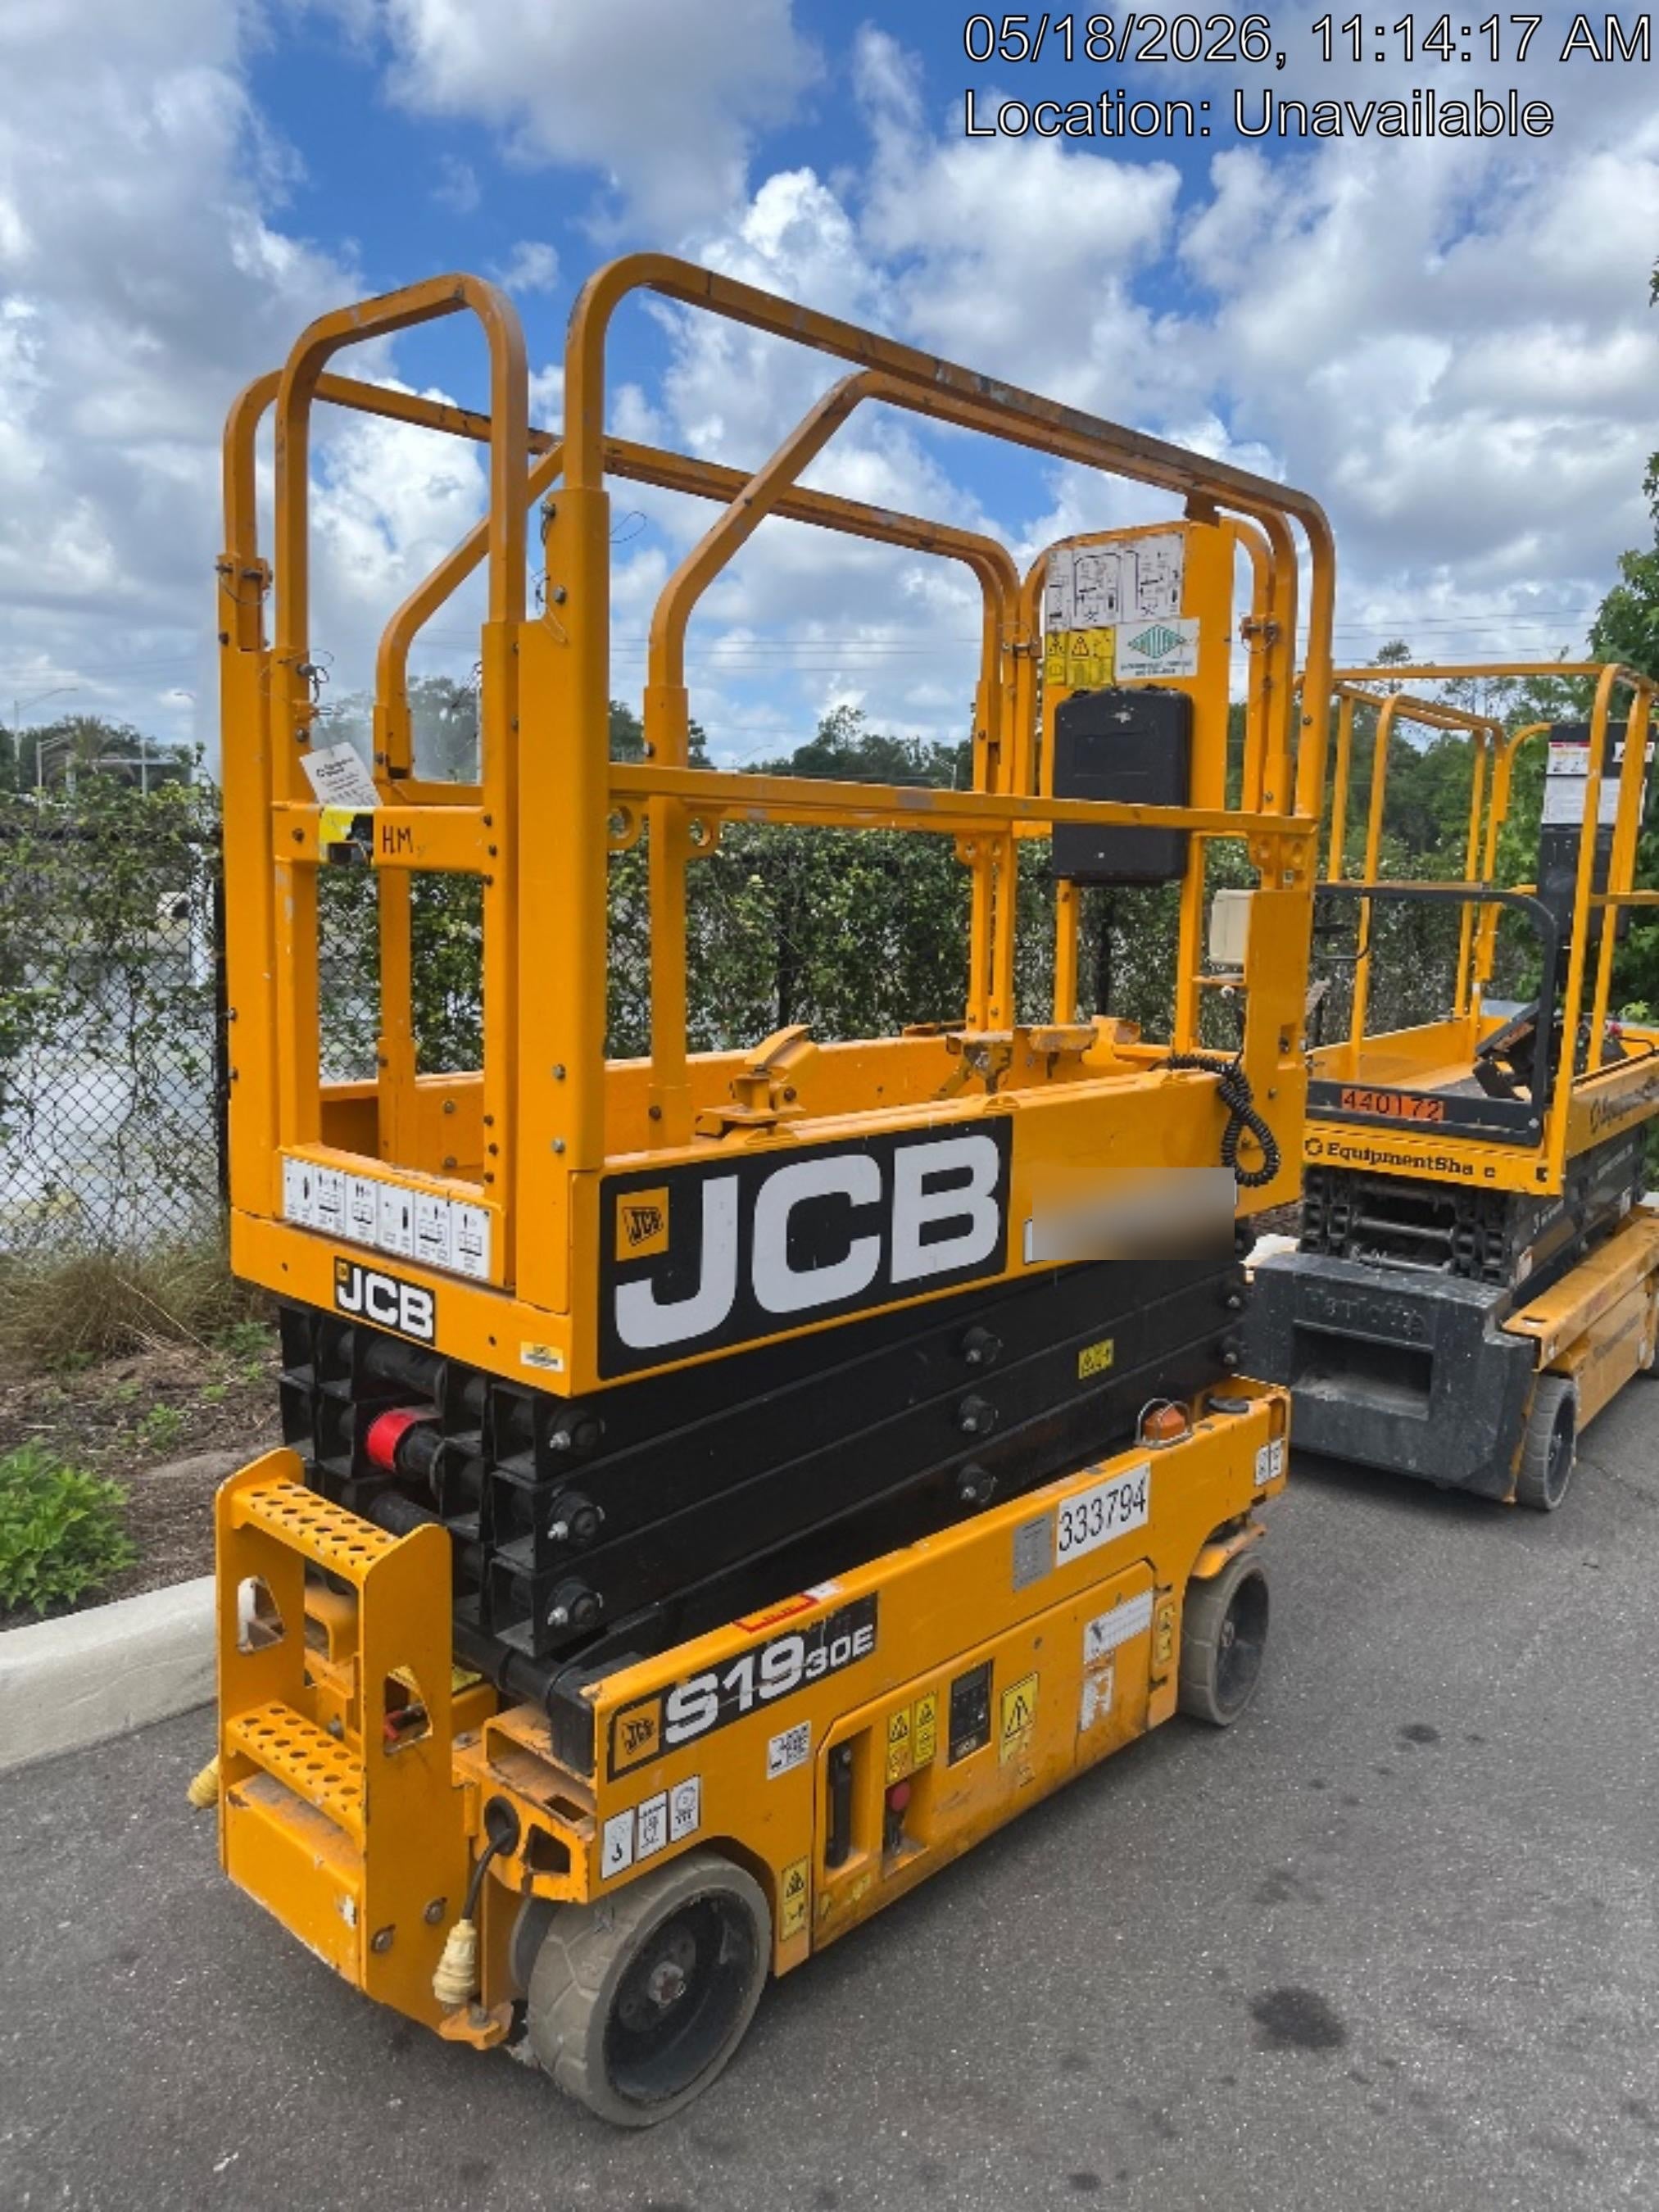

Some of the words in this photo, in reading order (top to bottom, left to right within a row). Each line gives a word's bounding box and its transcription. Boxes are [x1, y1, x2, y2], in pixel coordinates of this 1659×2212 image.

[1342, 1089, 1441, 1122] 440172
[614, 1135, 1000, 1349] JCB
[337, 1267, 433, 1339] JCB
[1058, 1475, 1147, 1552] 333794
